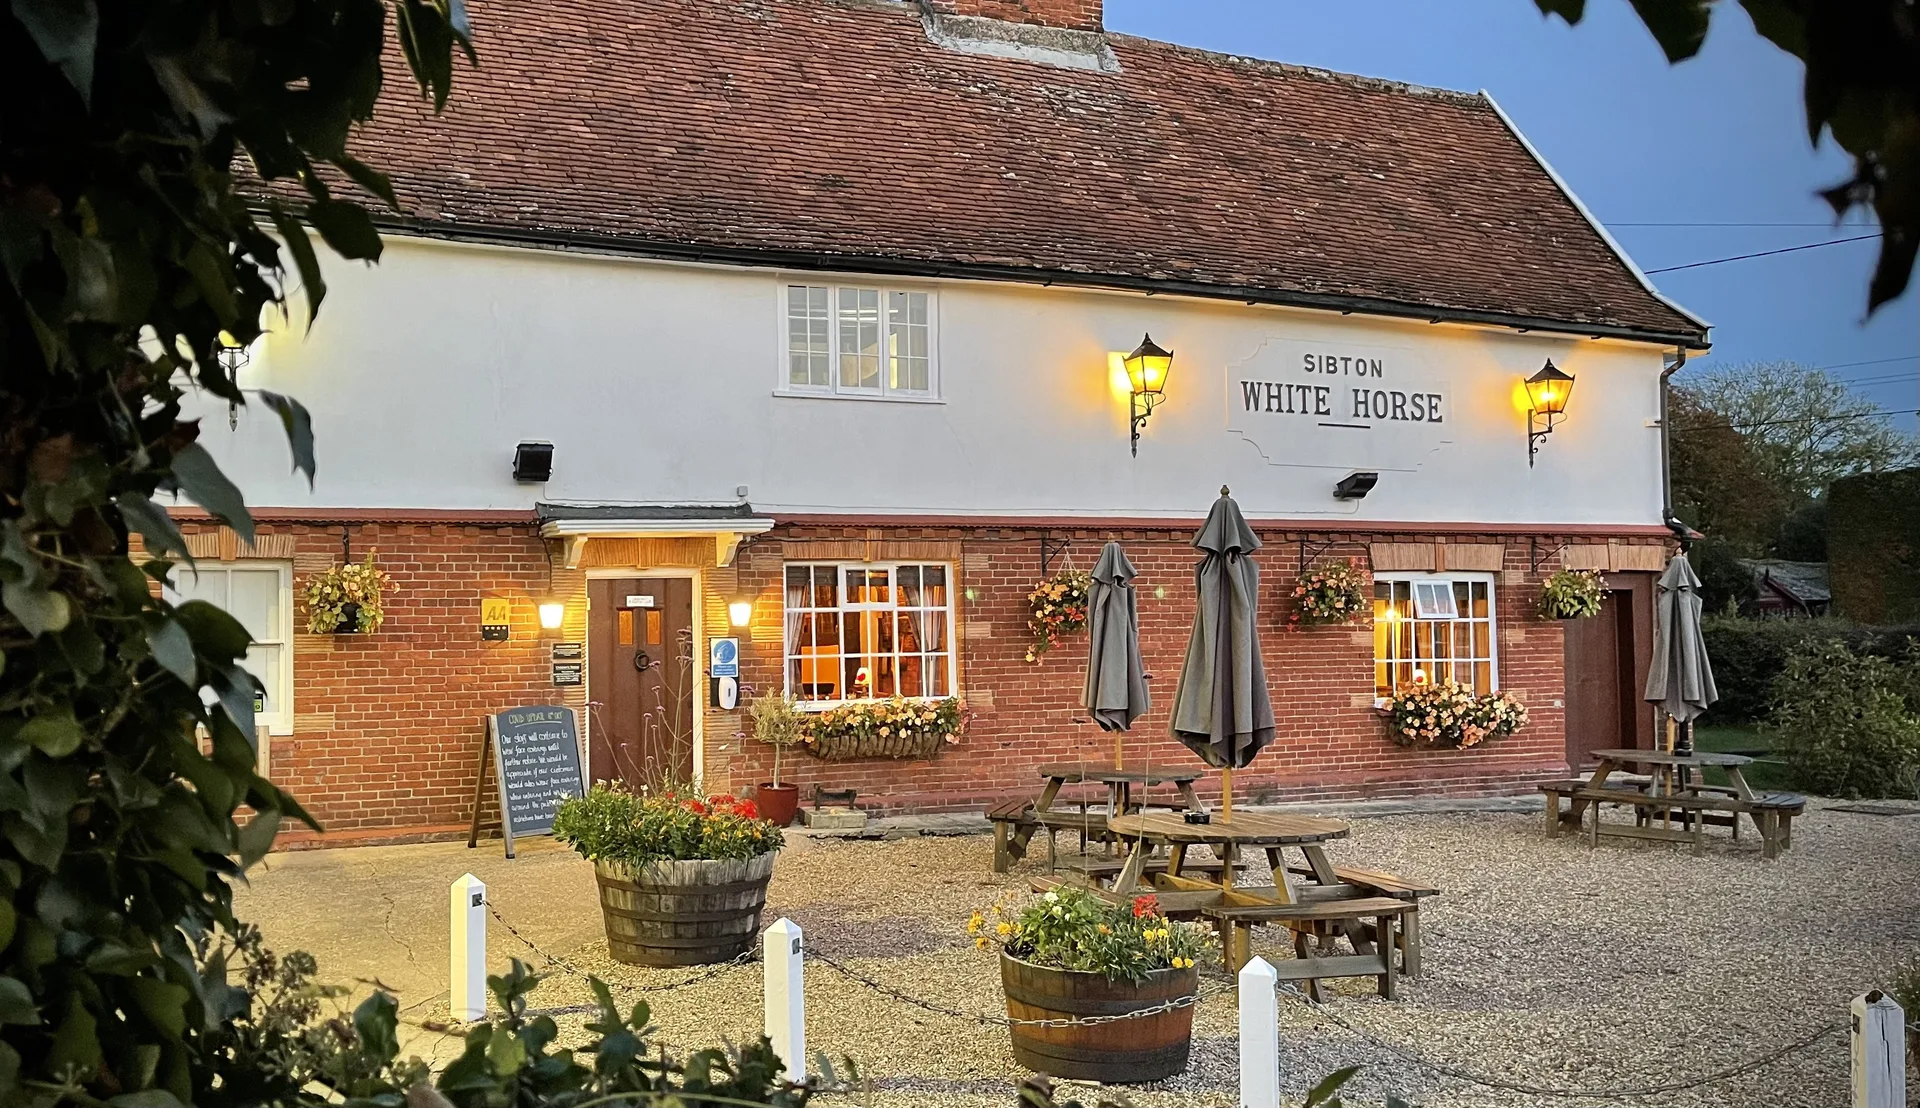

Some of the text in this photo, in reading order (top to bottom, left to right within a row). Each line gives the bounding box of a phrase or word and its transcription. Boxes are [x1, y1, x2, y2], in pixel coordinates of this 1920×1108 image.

[1303, 353, 1383, 378] SIBTON
[1240, 380, 1443, 423] WHITE HORSE
[485, 605, 506, 621] AA
